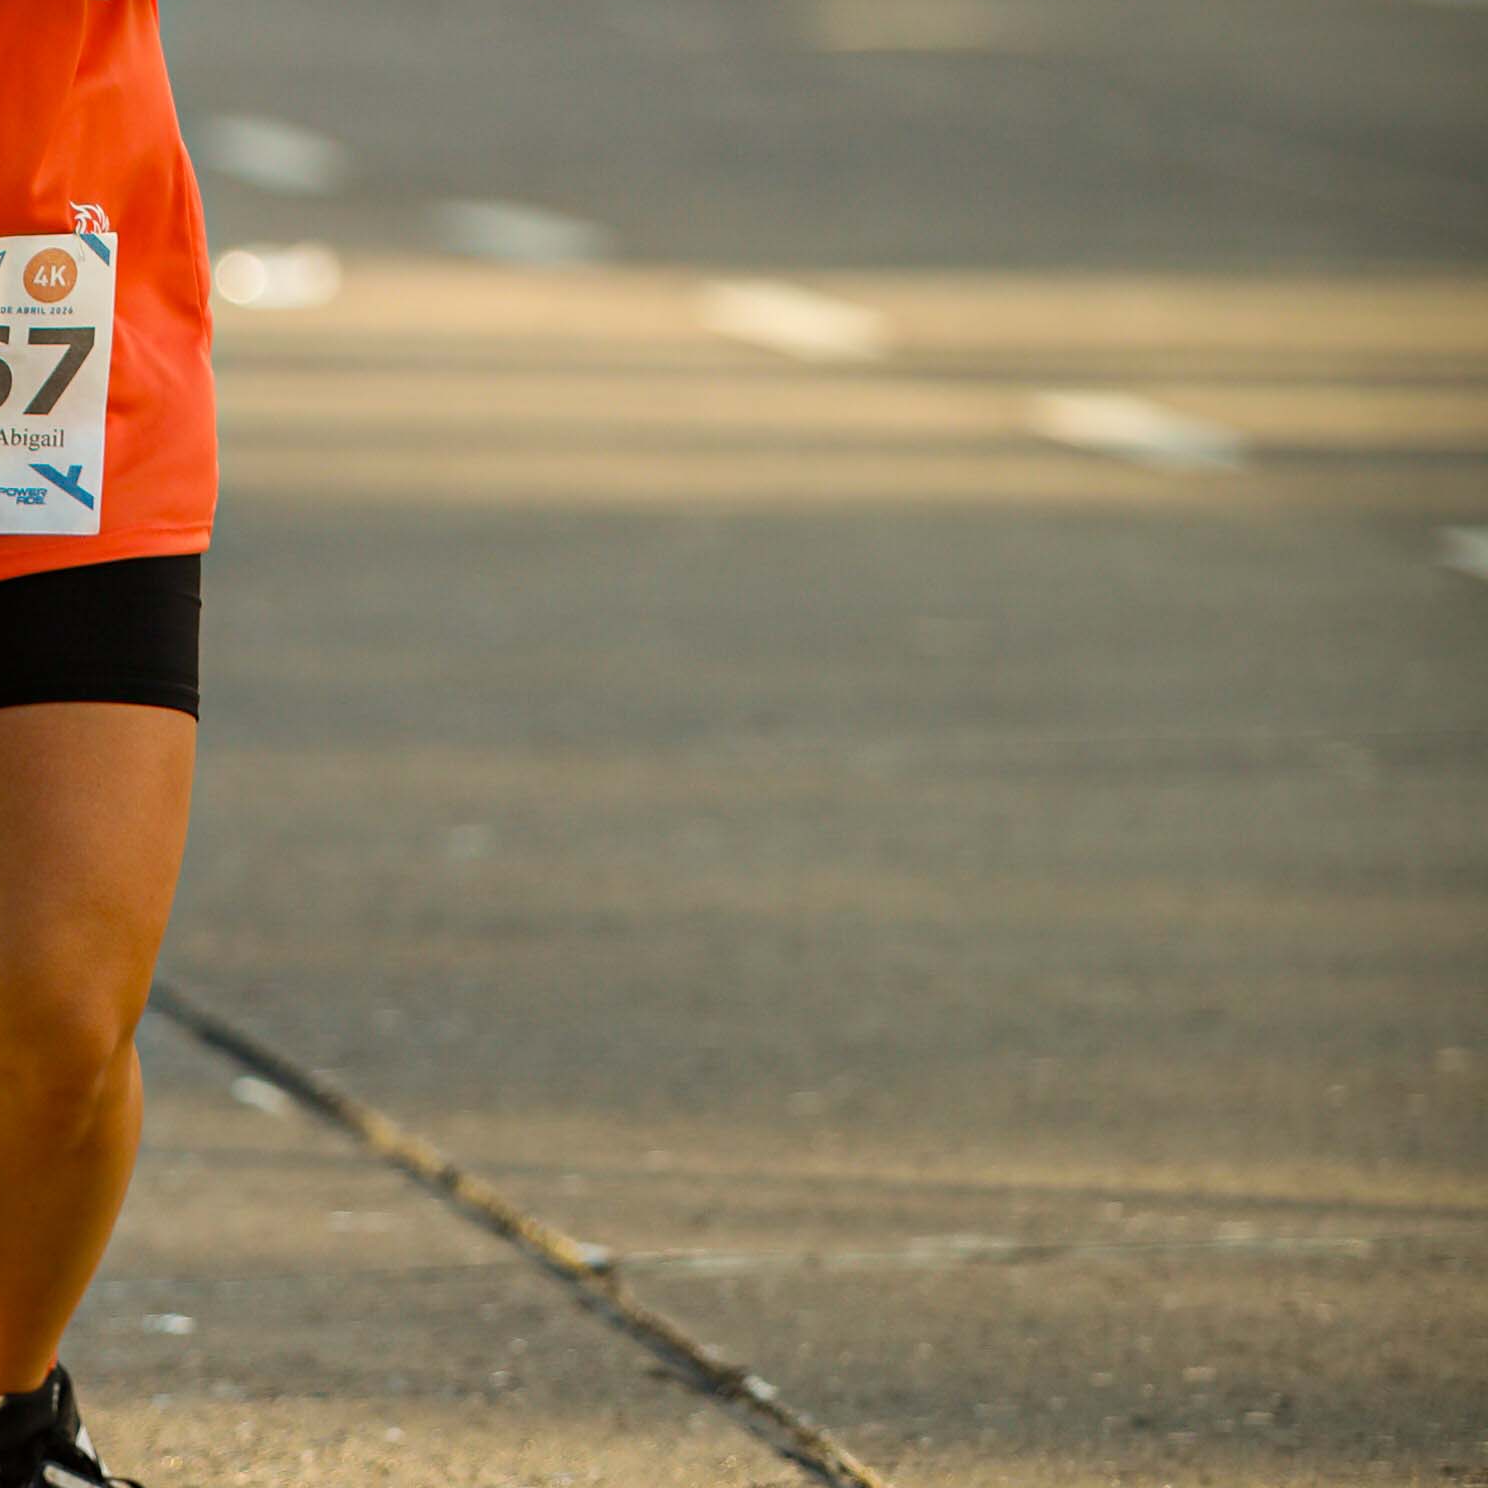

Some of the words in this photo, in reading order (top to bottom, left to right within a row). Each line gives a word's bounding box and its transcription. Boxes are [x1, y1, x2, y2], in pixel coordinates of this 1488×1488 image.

[33, 265, 67, 289] 4K
[0, 306, 12, 314] DE
[17, 306, 46, 315] ABRIL
